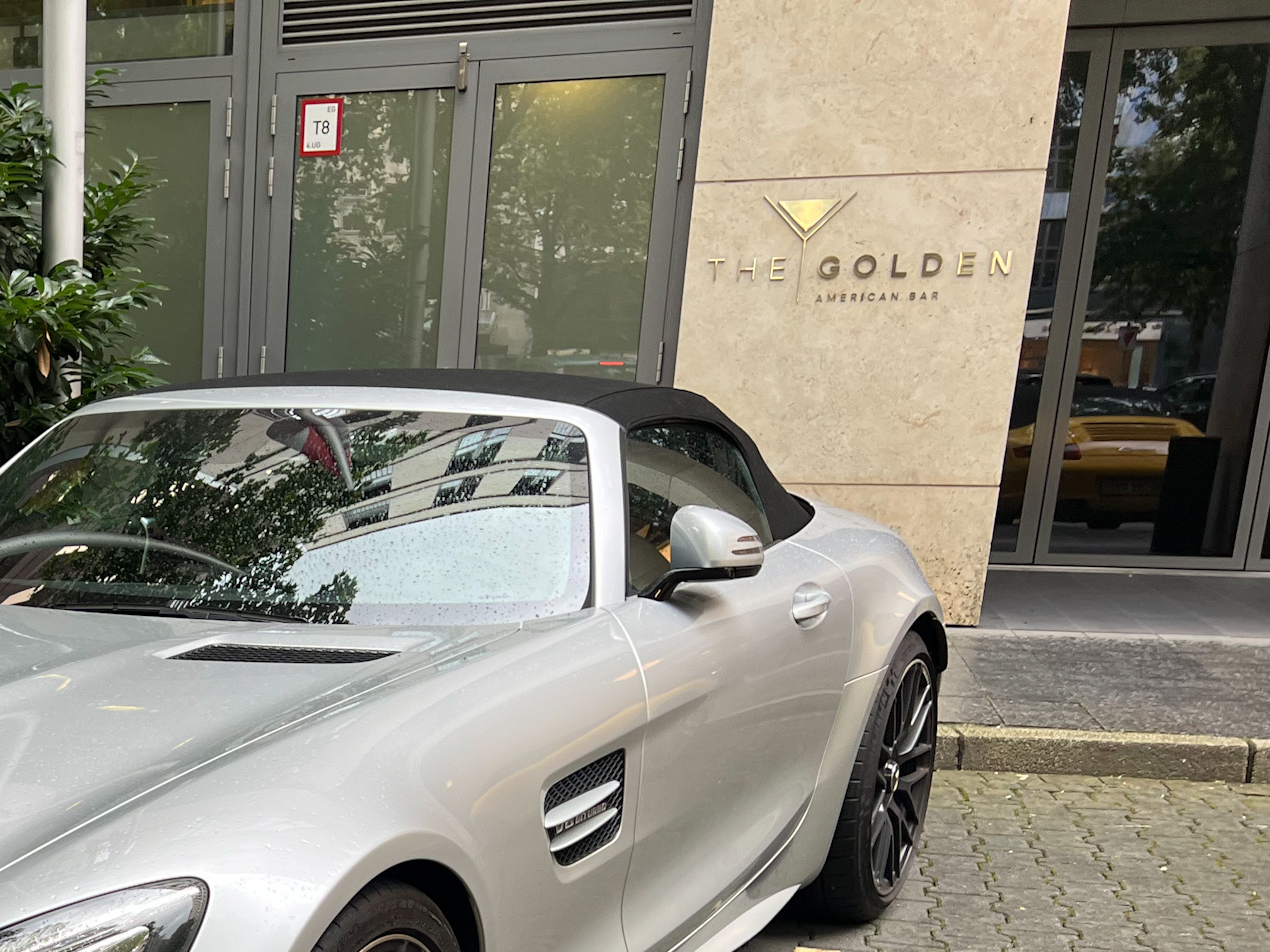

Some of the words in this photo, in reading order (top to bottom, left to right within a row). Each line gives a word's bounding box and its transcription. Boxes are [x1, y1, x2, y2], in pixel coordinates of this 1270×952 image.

[313, 120, 330, 135] T8
[707, 257, 786, 282] THE
[818, 251, 1013, 279] GOLDEN
[814, 292, 899, 303] AMERICAN
[909, 291, 939, 301] BAR
